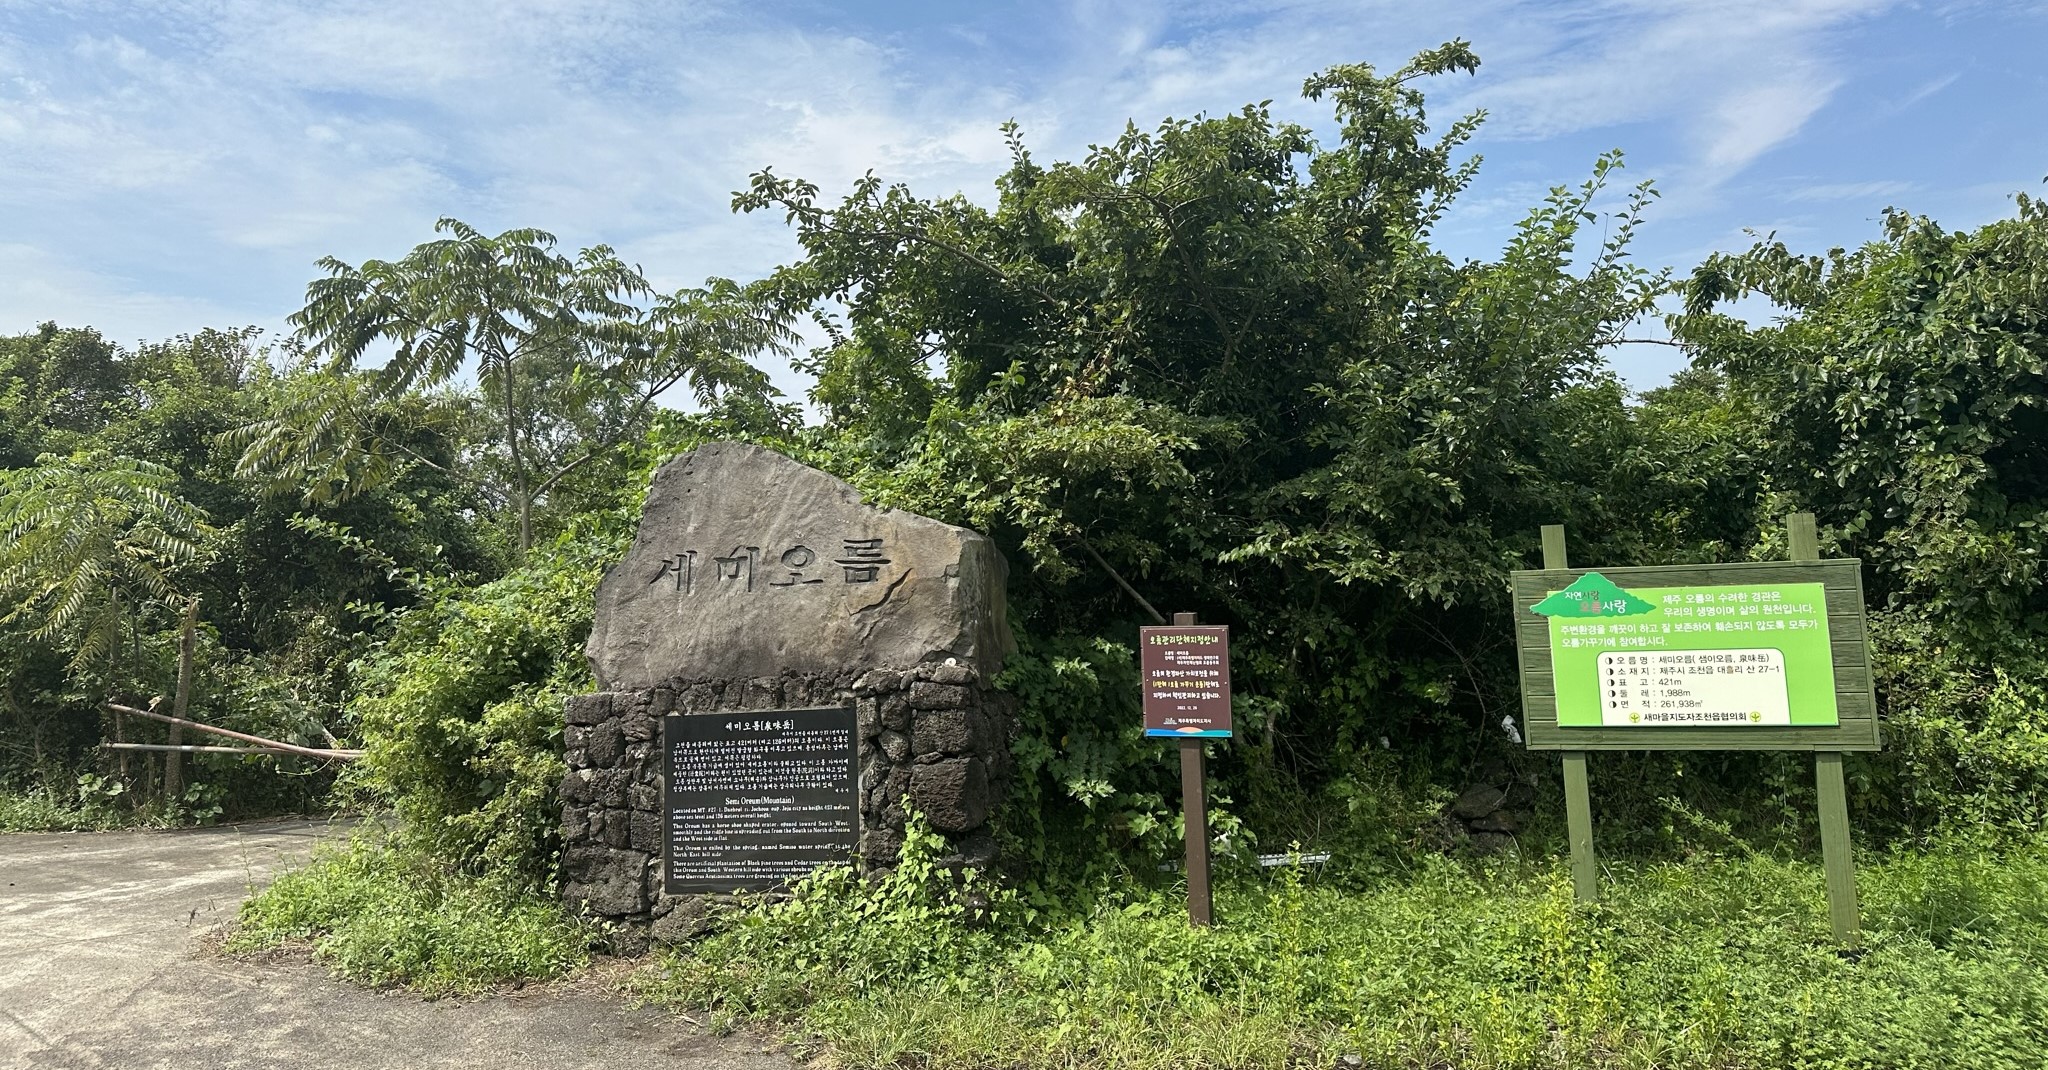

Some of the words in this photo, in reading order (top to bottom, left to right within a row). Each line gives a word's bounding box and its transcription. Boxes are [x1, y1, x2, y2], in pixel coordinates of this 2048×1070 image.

[649, 538, 892, 595] 세미오름
[1663, 594, 1681, 605] 제주
[1685, 593, 1715, 604] 오름의
[1718, 592, 1748, 603] 수려한
[1751, 591, 1782, 602] 경관은
[1664, 606, 1693, 617] 우리의
[1696, 605, 1735, 617] 생명이며
[1740, 604, 1759, 616] 삶의
[1763, 603, 1817, 615] 원천입니다.
[1560, 625, 1606, 636] 주변환경을
[1609, 624, 1637, 635] 깨끗이
[1640, 623, 1659, 634] 하고
[1661, 623, 1671, 633] 잘
[1674, 622, 1712, 633] 보존하여
[1715, 621, 1753, 632] 훼손되지
[1756, 620, 1785, 631] 않도록
[1789, 619, 1819, 630] 모두가
[1150, 635, 1219, 645] 오름관리단체지정안내
[1562, 637, 1616, 649] 오름가꾸기에
[1619, 636, 1669, 648] 참여합시다.
[1659, 666, 1685, 675] 제주시
[1687, 666, 1714, 675] 조천읍
[1746, 665, 1755, 674] 산
[1758, 665, 1780, 674] 27-1
[1658, 678, 1682, 686] 421m
[1660, 689, 1691, 698] 1,988m
[1643, 712, 1747, 722] 새마을지도자조천읍협의회
